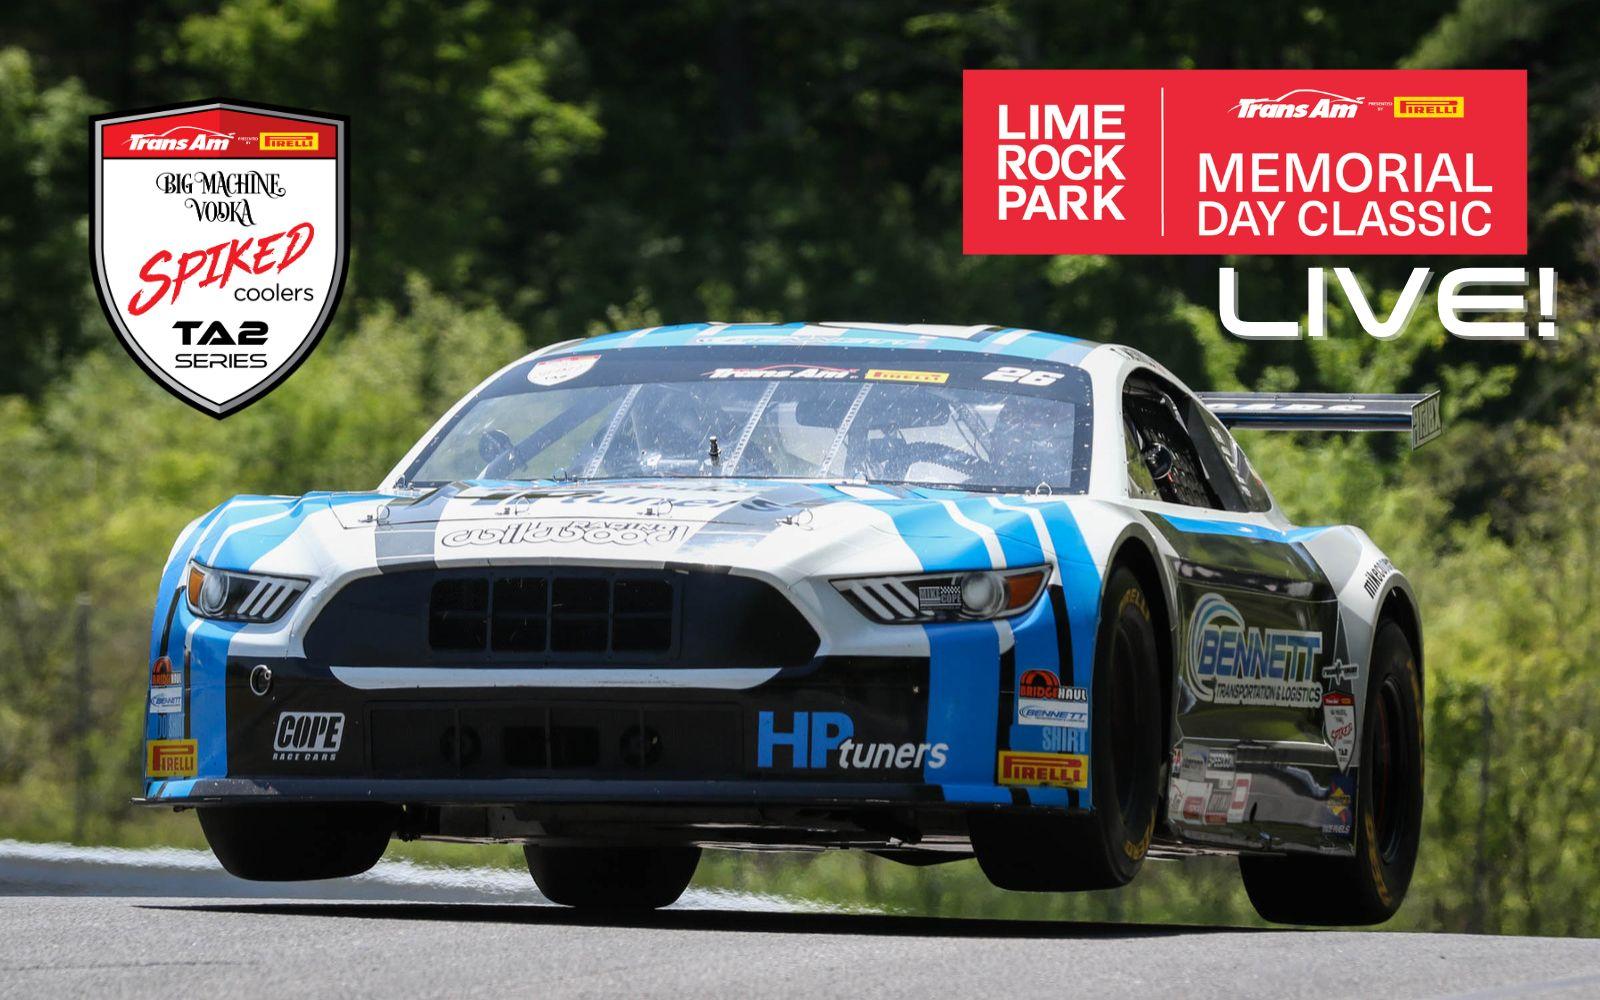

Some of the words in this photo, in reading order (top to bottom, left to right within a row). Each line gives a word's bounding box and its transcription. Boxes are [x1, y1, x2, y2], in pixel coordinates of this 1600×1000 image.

[710, 368, 793, 379] Trans
[791, 368, 850, 380] Am
[981, 366, 1065, 387] 26
[1196, 628, 1322, 681] BENNETT
[1216, 683, 1276, 701] TRANSPORTATION
[1281, 685, 1321, 703] LOGISTICS
[1026, 708, 1088, 720] BENNETT
[276, 714, 343, 749] COPE
[1042, 727, 1088, 753] SHIRT
[152, 744, 195, 771] PIRELLI
[272, 752, 300, 762] RACE
[305, 752, 337, 762] CARS
[1002, 755, 1084, 783] PIRELLI
